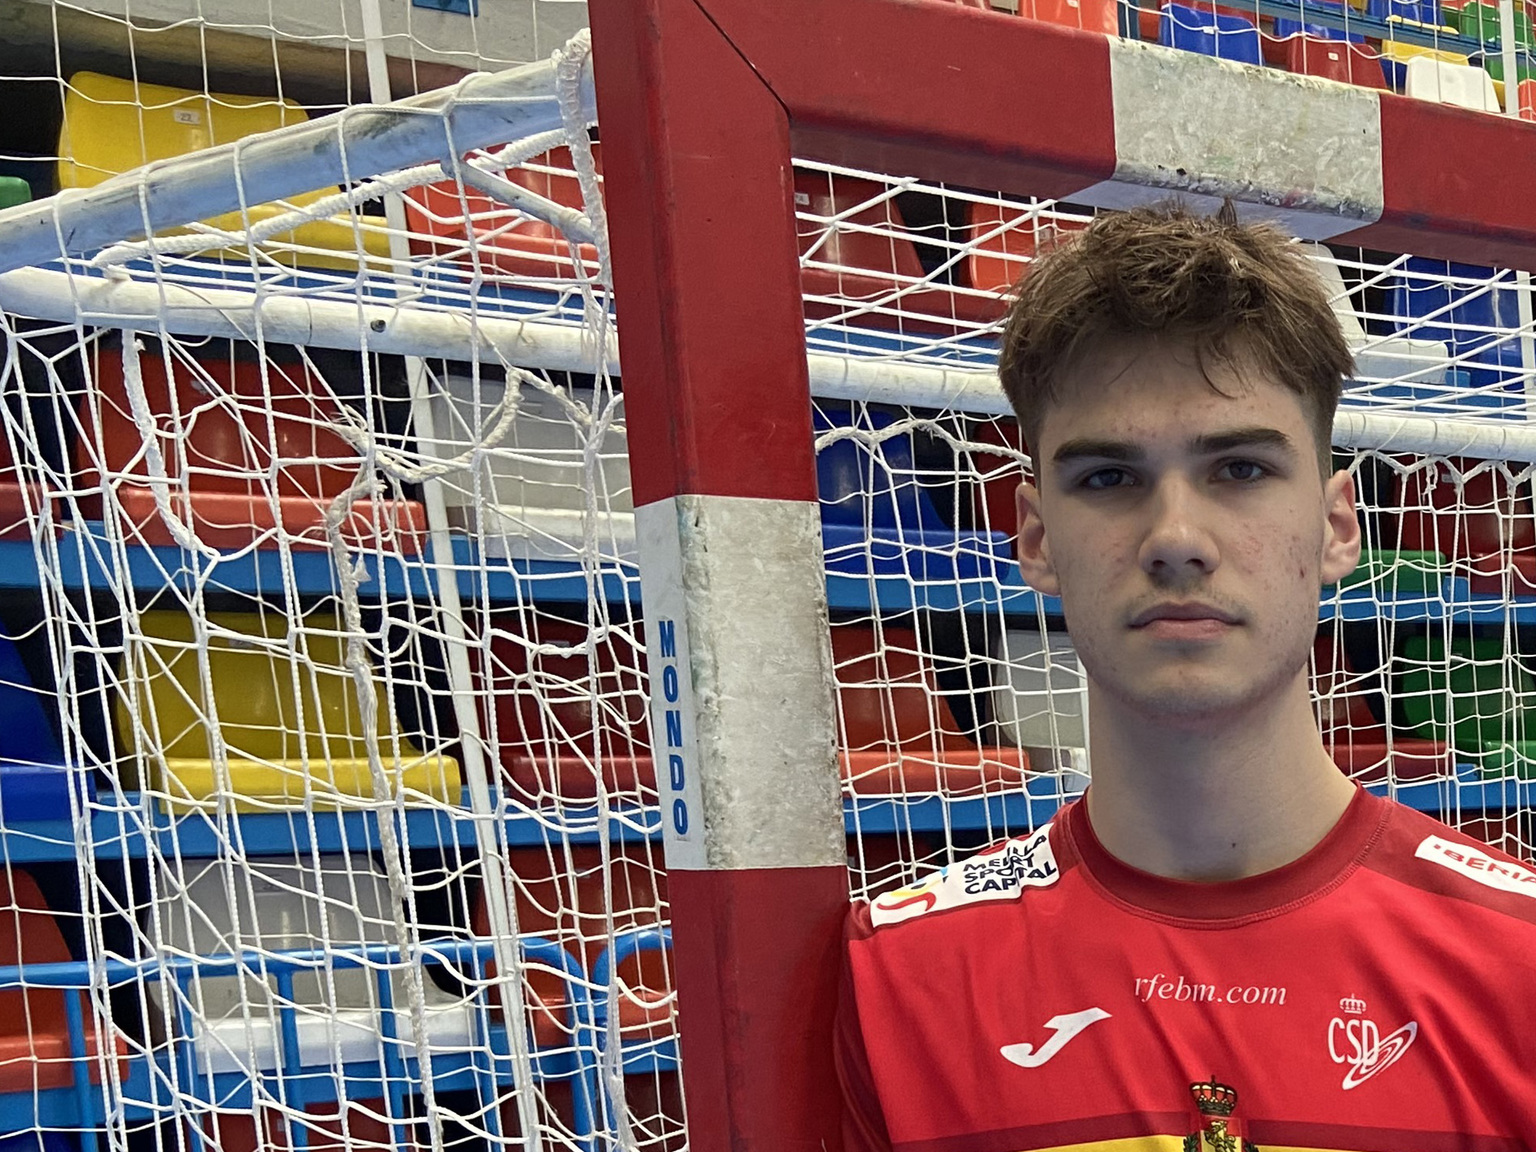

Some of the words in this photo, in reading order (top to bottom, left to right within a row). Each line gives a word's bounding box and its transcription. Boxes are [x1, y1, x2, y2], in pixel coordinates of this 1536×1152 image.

[658, 619, 688, 835] MONDO
[1134, 973, 1287, 1006] rfebm.com
[1328, 1017, 1379, 1066] CSD
